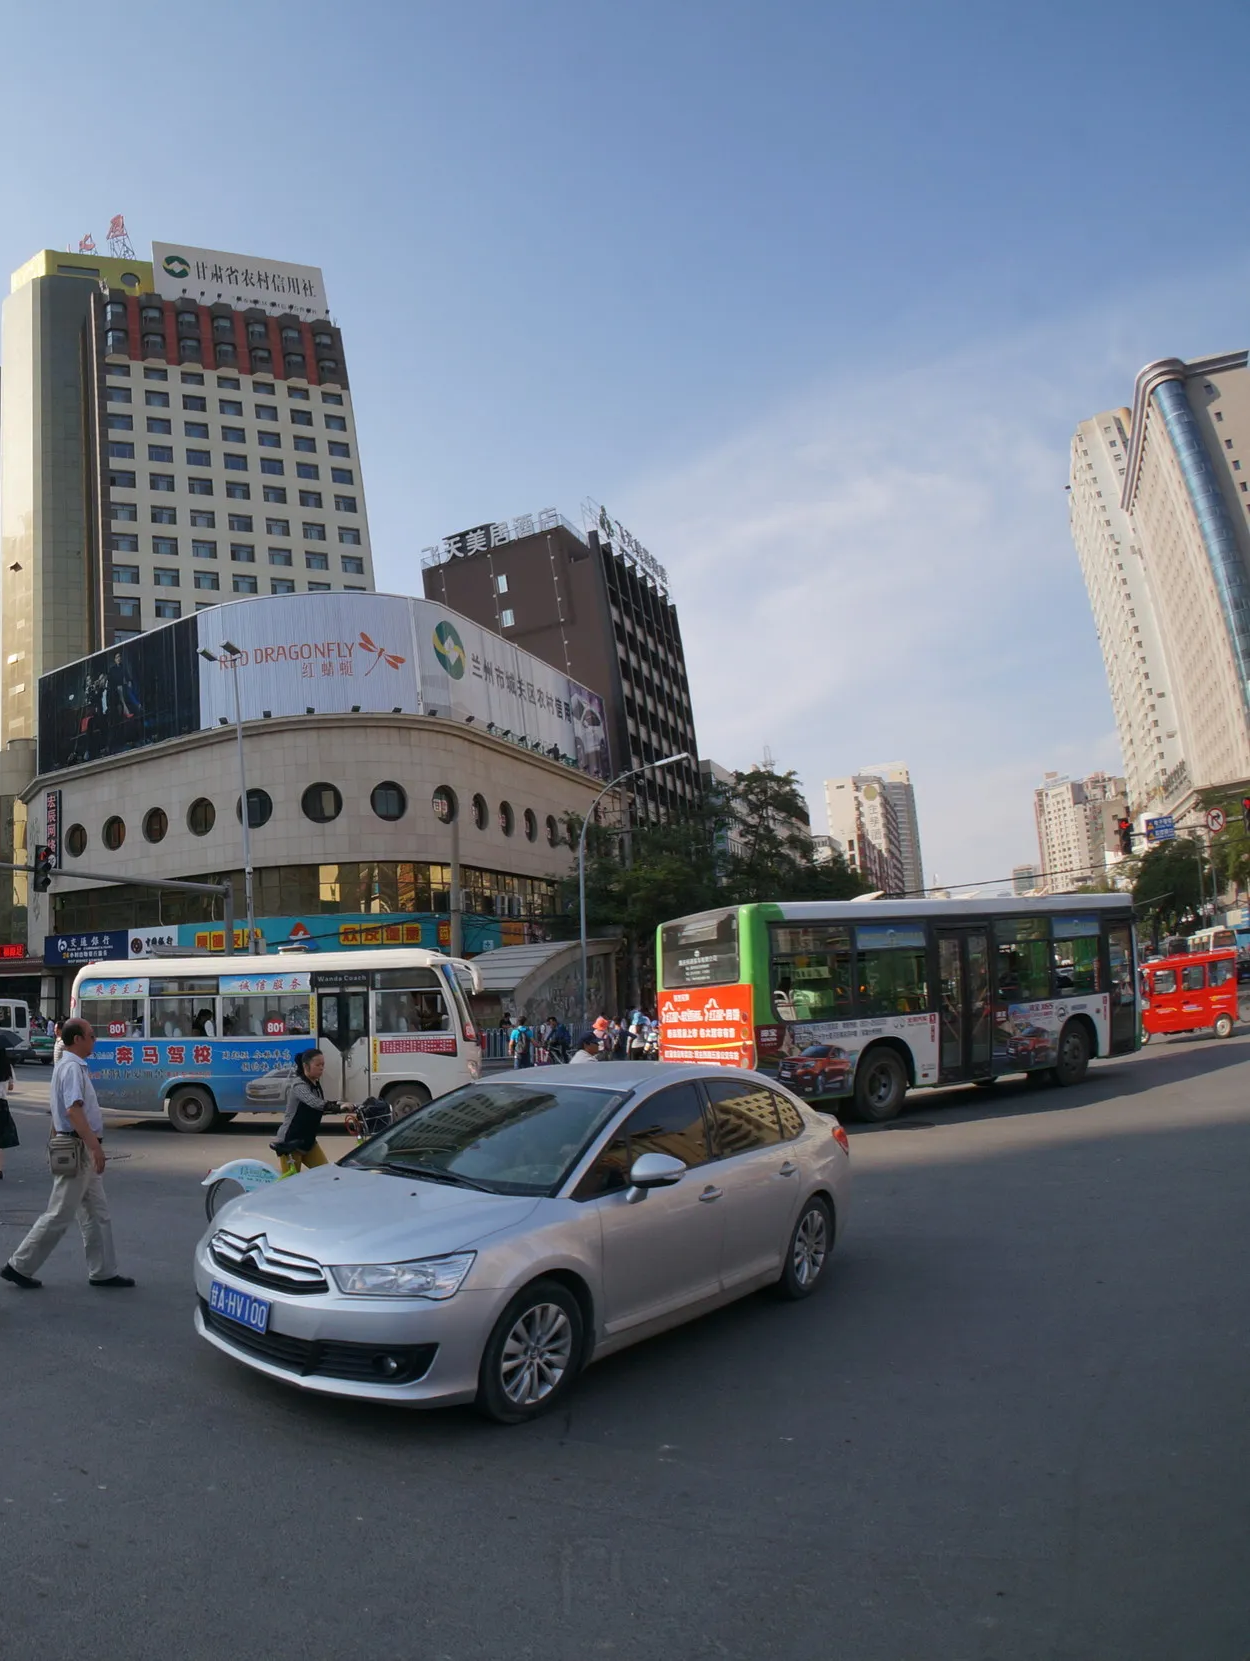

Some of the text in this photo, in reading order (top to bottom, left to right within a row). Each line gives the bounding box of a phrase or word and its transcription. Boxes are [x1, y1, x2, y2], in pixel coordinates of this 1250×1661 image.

[193, 260, 317, 299] 甘肃省农村信用社
[254, 642, 355, 665] DRAGONFLY
[302, 661, 354, 679] 红蜻蜓
[70, 935, 110, 948] 交通银行
[95, 983, 143, 995] 乘客至上
[239, 978, 302, 992] 诚信服务
[109, 1023, 125, 1034] 801
[267, 1022, 284, 1033] 801
[115, 1045, 212, 1065] 奔马驾校
